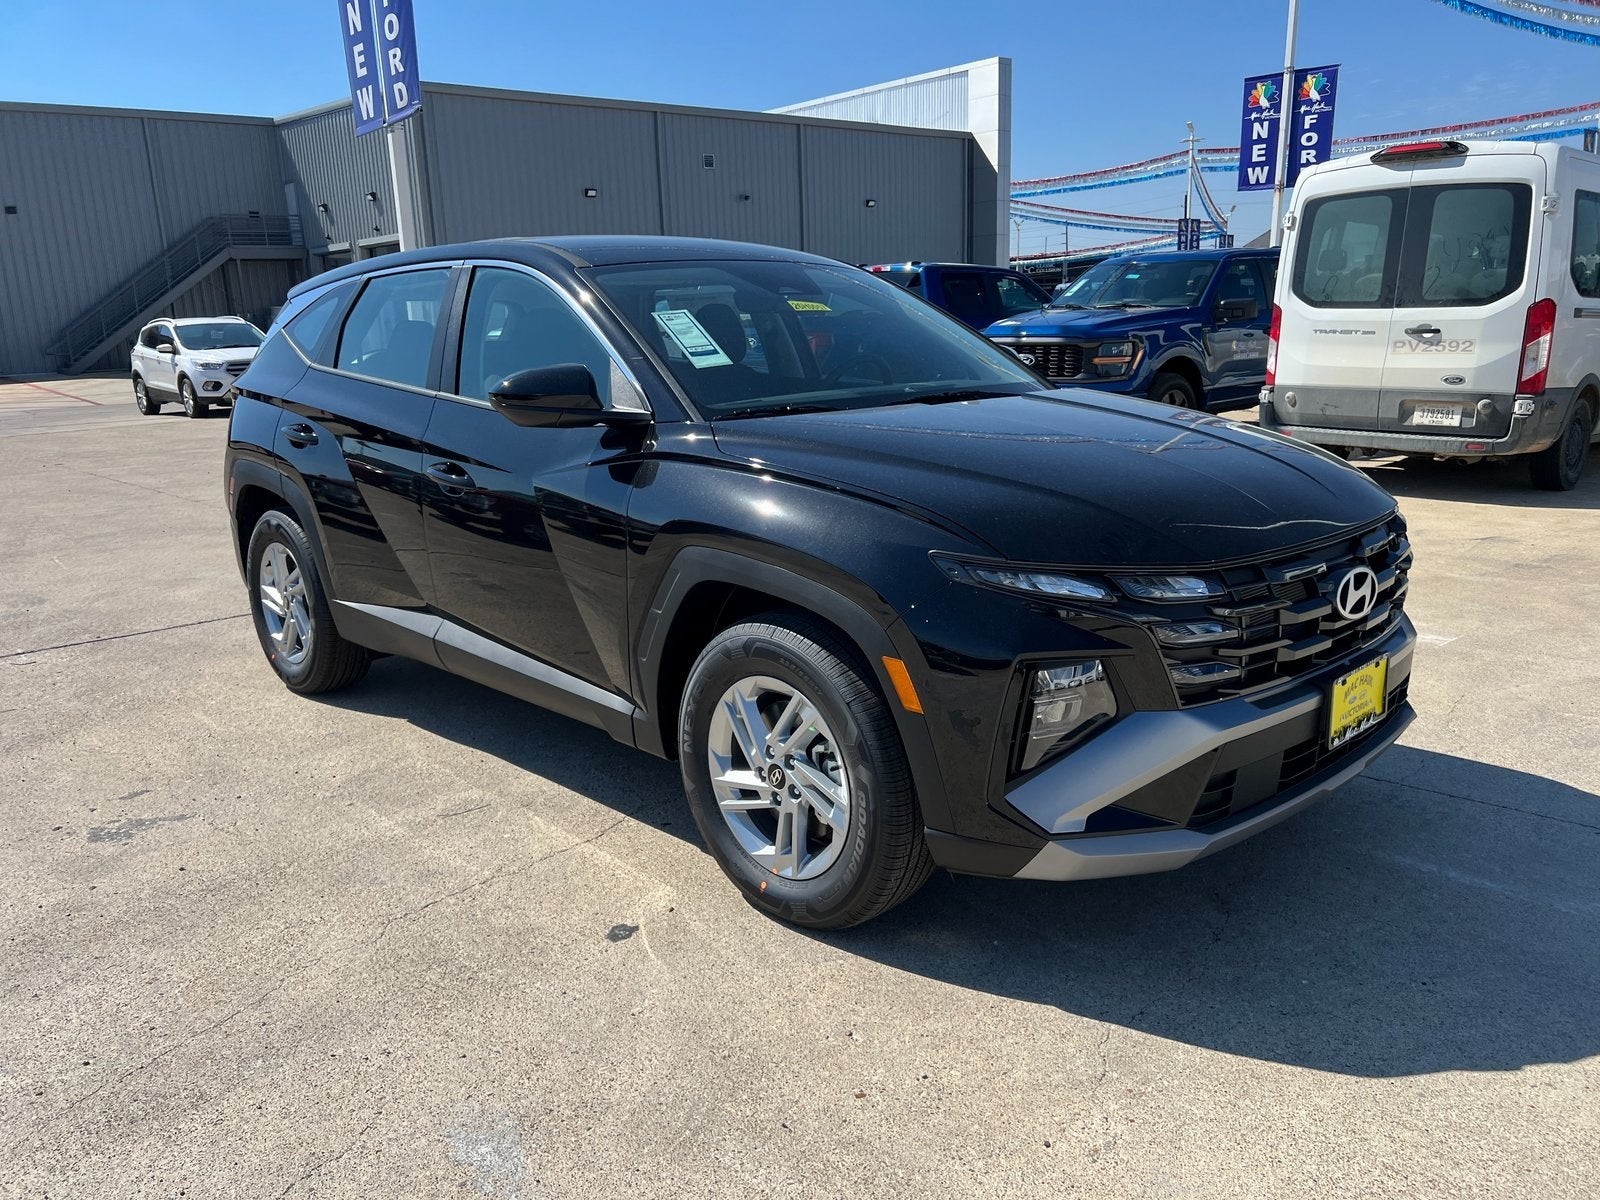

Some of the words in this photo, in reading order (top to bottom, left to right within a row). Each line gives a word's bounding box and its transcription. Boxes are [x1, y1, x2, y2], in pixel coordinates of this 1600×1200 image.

[346, 0, 374, 120] NEW
[383, 0, 408, 109] ORD
[1247, 121, 1269, 185] NEW
[1300, 114, 1318, 171] FOR
[1393, 340, 1474, 353] PV2592
